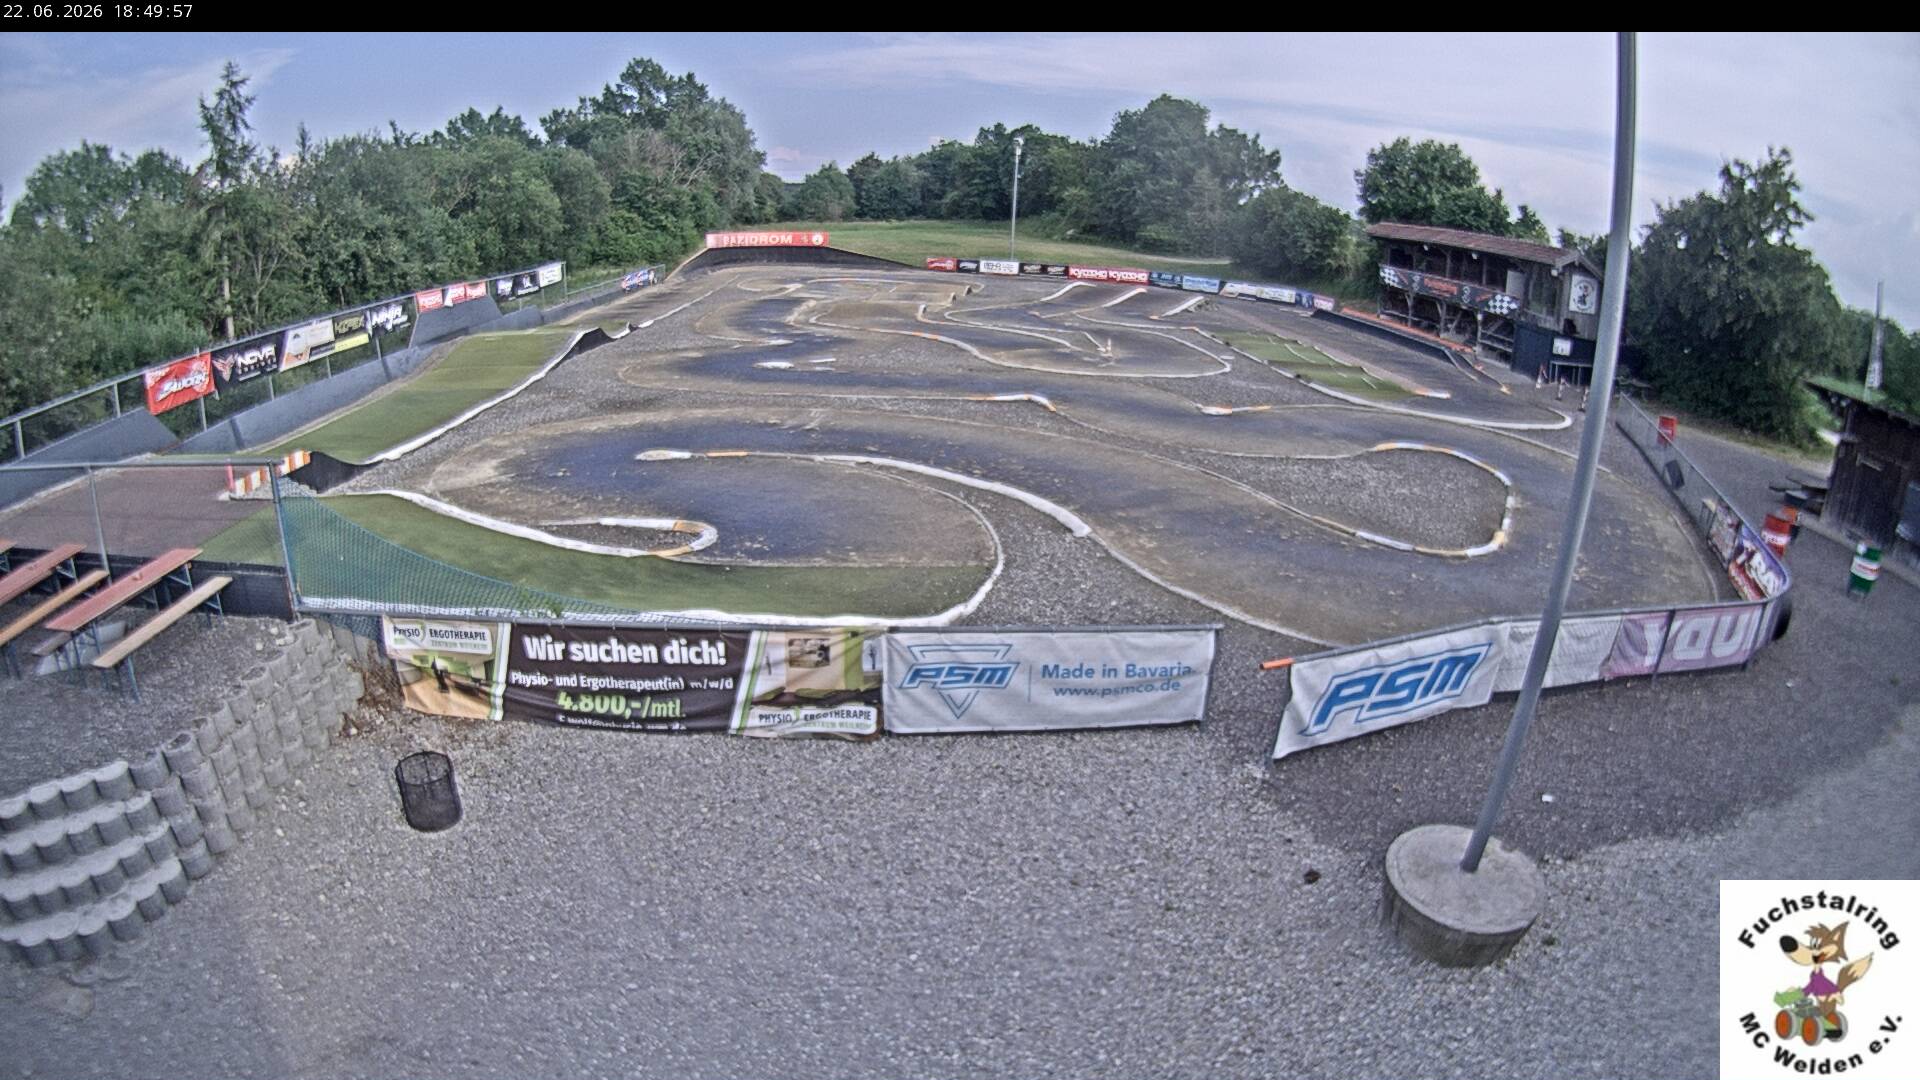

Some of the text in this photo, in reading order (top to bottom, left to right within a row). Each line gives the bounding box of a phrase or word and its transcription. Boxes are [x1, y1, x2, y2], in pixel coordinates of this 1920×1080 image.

[429, 628, 487, 641] ERGOTHERAPIE
[521, 633, 727, 666] Wir suchen dich!
[903, 664, 1017, 688] PSM
[1041, 662, 1192, 679] Made in Bavaria
[509, 670, 733, 692] Physio- und Ergotherapeut(in) m/w/d
[1053, 679, 1181, 698] www.psmco.de
[1308, 648, 1487, 732] PSM
[758, 713, 793, 725] PHYSIO
[803, 710, 873, 722] ERGOTHERAPIE
